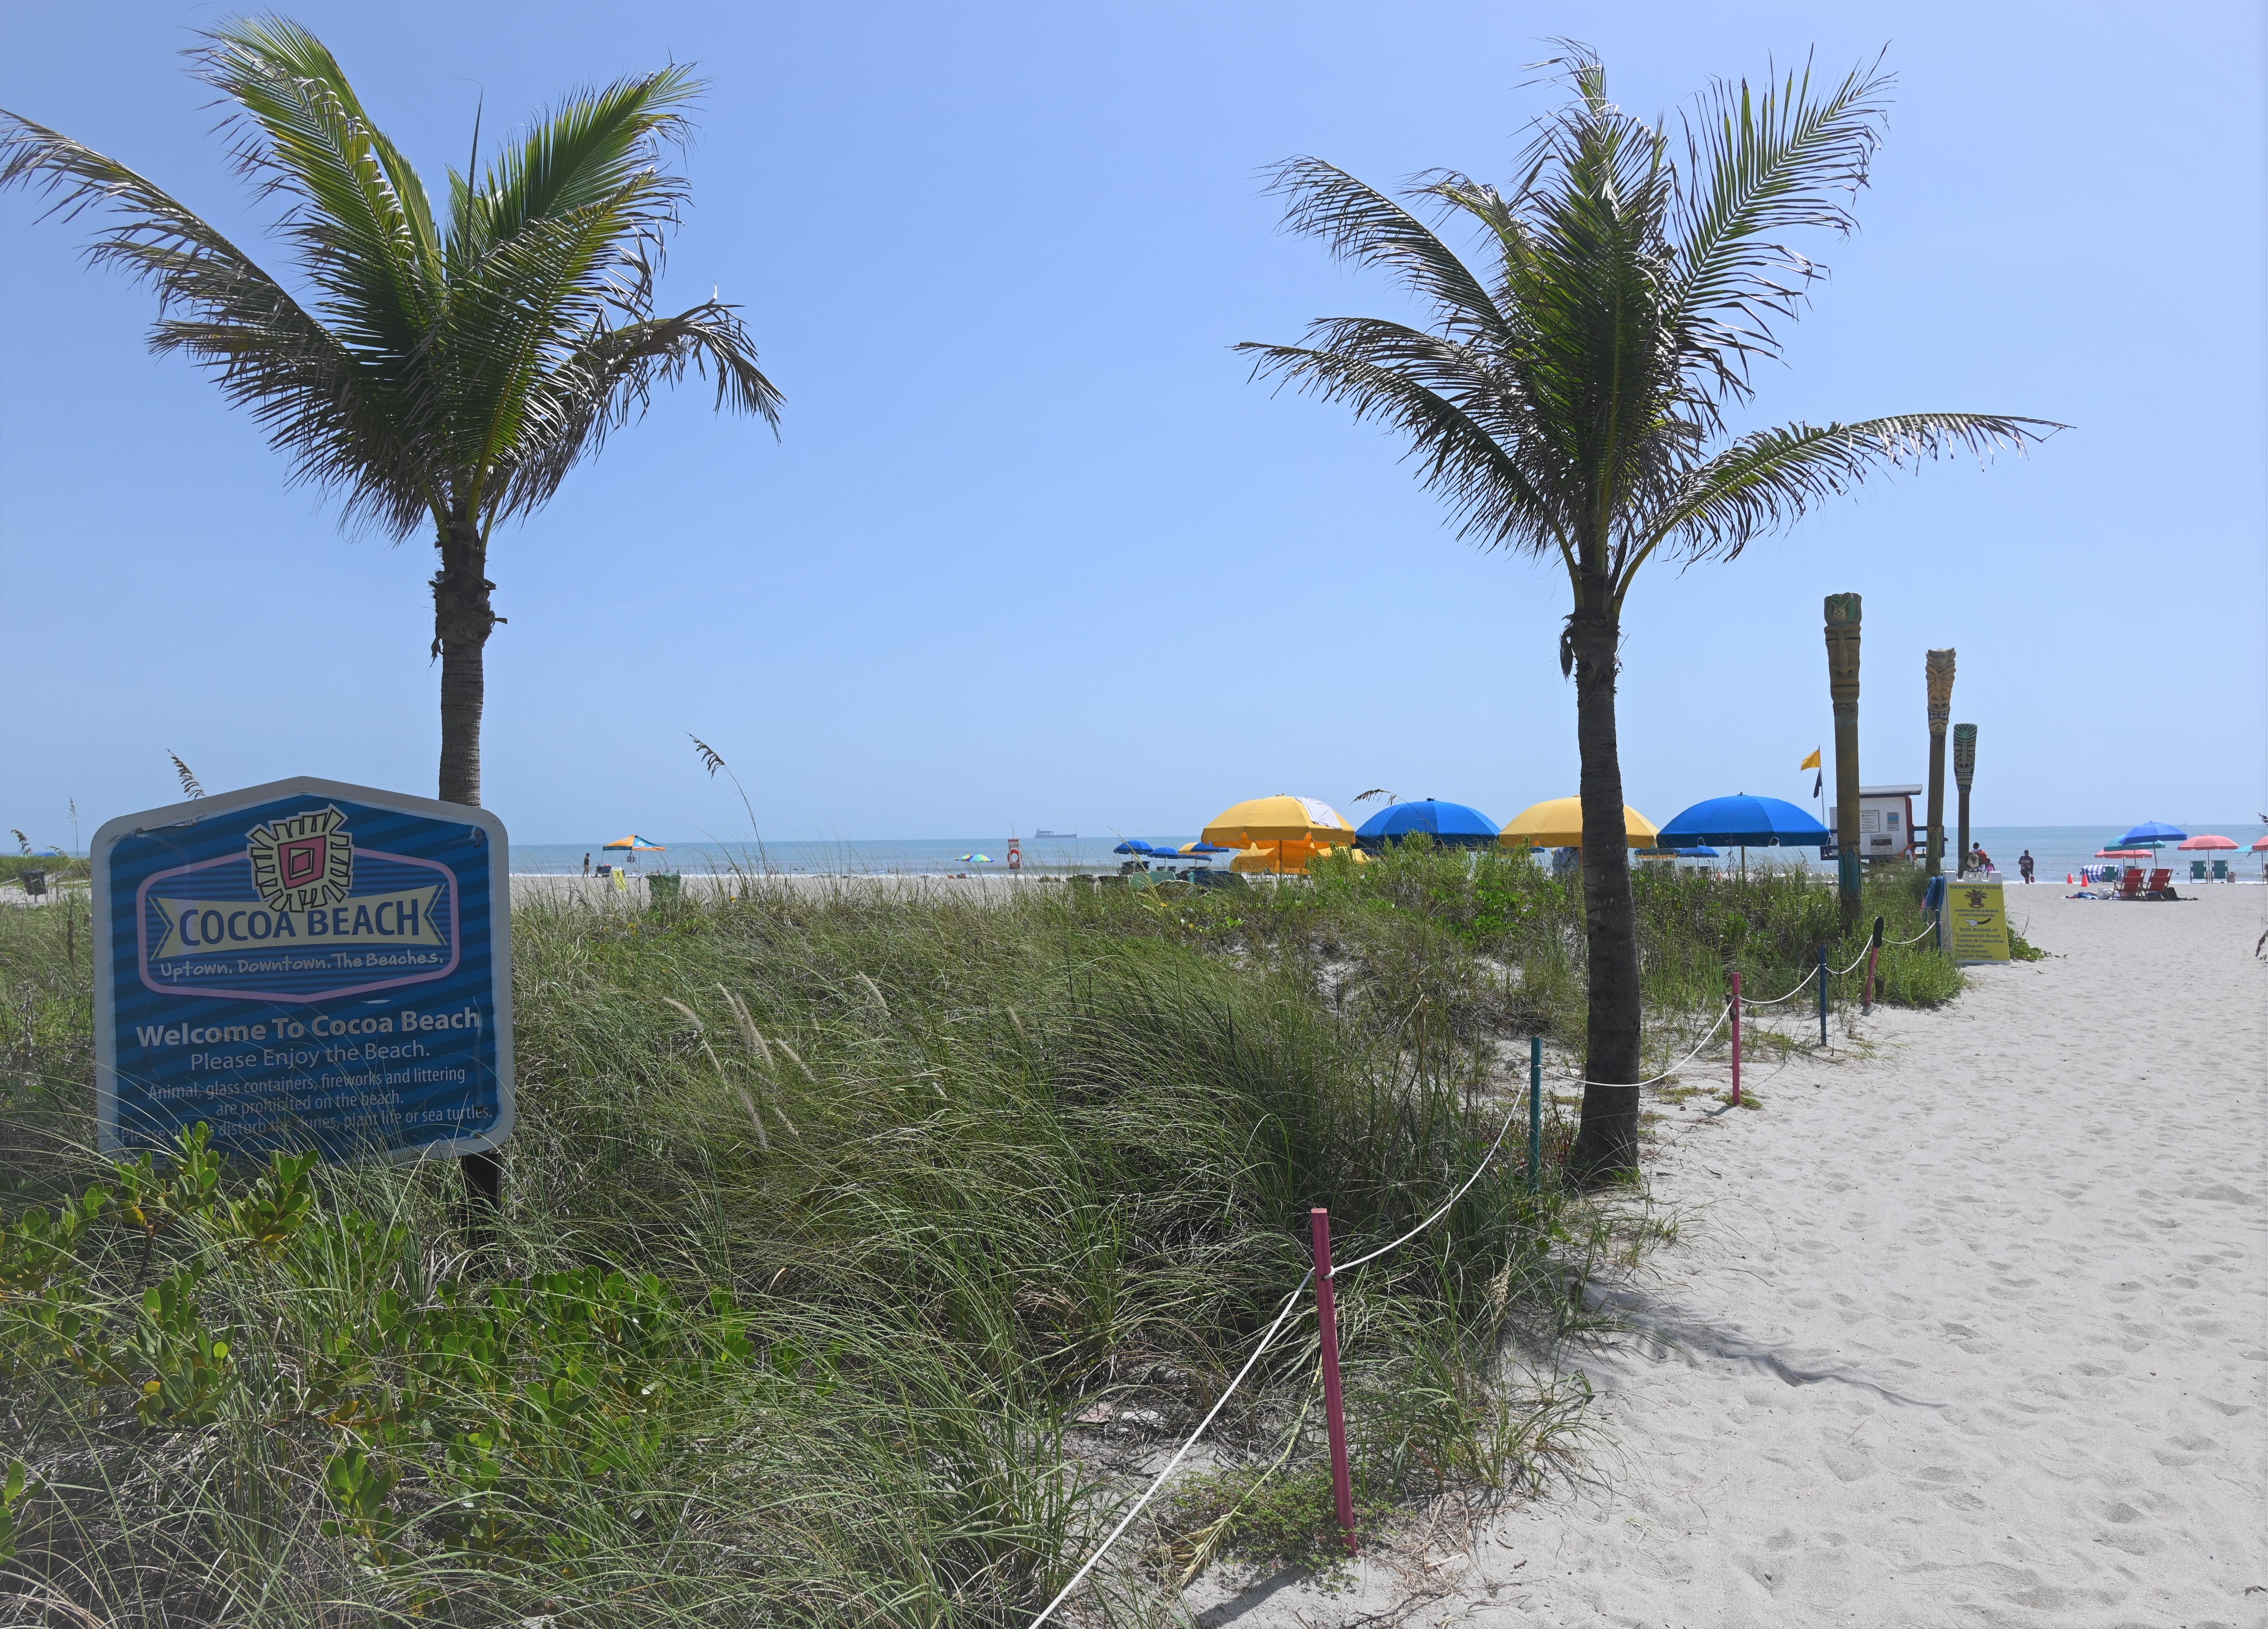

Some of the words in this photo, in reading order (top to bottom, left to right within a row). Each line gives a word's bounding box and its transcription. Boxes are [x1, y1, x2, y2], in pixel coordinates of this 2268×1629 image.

[179, 909, 297, 946] COCOA
[307, 899, 419, 936] BEACH
[160, 960, 233, 982] Uptown.
[237, 955, 330, 973] Downtown.
[331, 952, 363, 968] The
[366, 949, 443, 967] Beaches.
[136, 1022, 266, 1047] Welcome
[272, 1018, 304, 1038] To
[311, 1015, 393, 1036] Cocoa
[401, 1007, 480, 1032] Beach
[191, 1052, 257, 1071] Please
[264, 1048, 319, 1069] Enjoy
[325, 1045, 359, 1063] the
[365, 1040, 430, 1060] Beach.
[148, 1081, 202, 1100] Animal,
[207, 1080, 240, 1100] glass
[244, 1077, 318, 1094] containers,
[321, 1070, 382, 1088] fireworks
[386, 1068, 410, 1084] and
[414, 1066, 466, 1084] littering
[216, 1104, 237, 1116] are
[242, 1095, 311, 1117] prohibited
[315, 1096, 332, 1110] on
[336, 1092, 357, 1108] the
[361, 1089, 404, 1106] beach.
[219, 1118, 266, 1136] disturb
[406, 1111, 419, 1123] or
[422, 1110, 443, 1123] sea
[447, 1104, 492, 1120] turtles.
